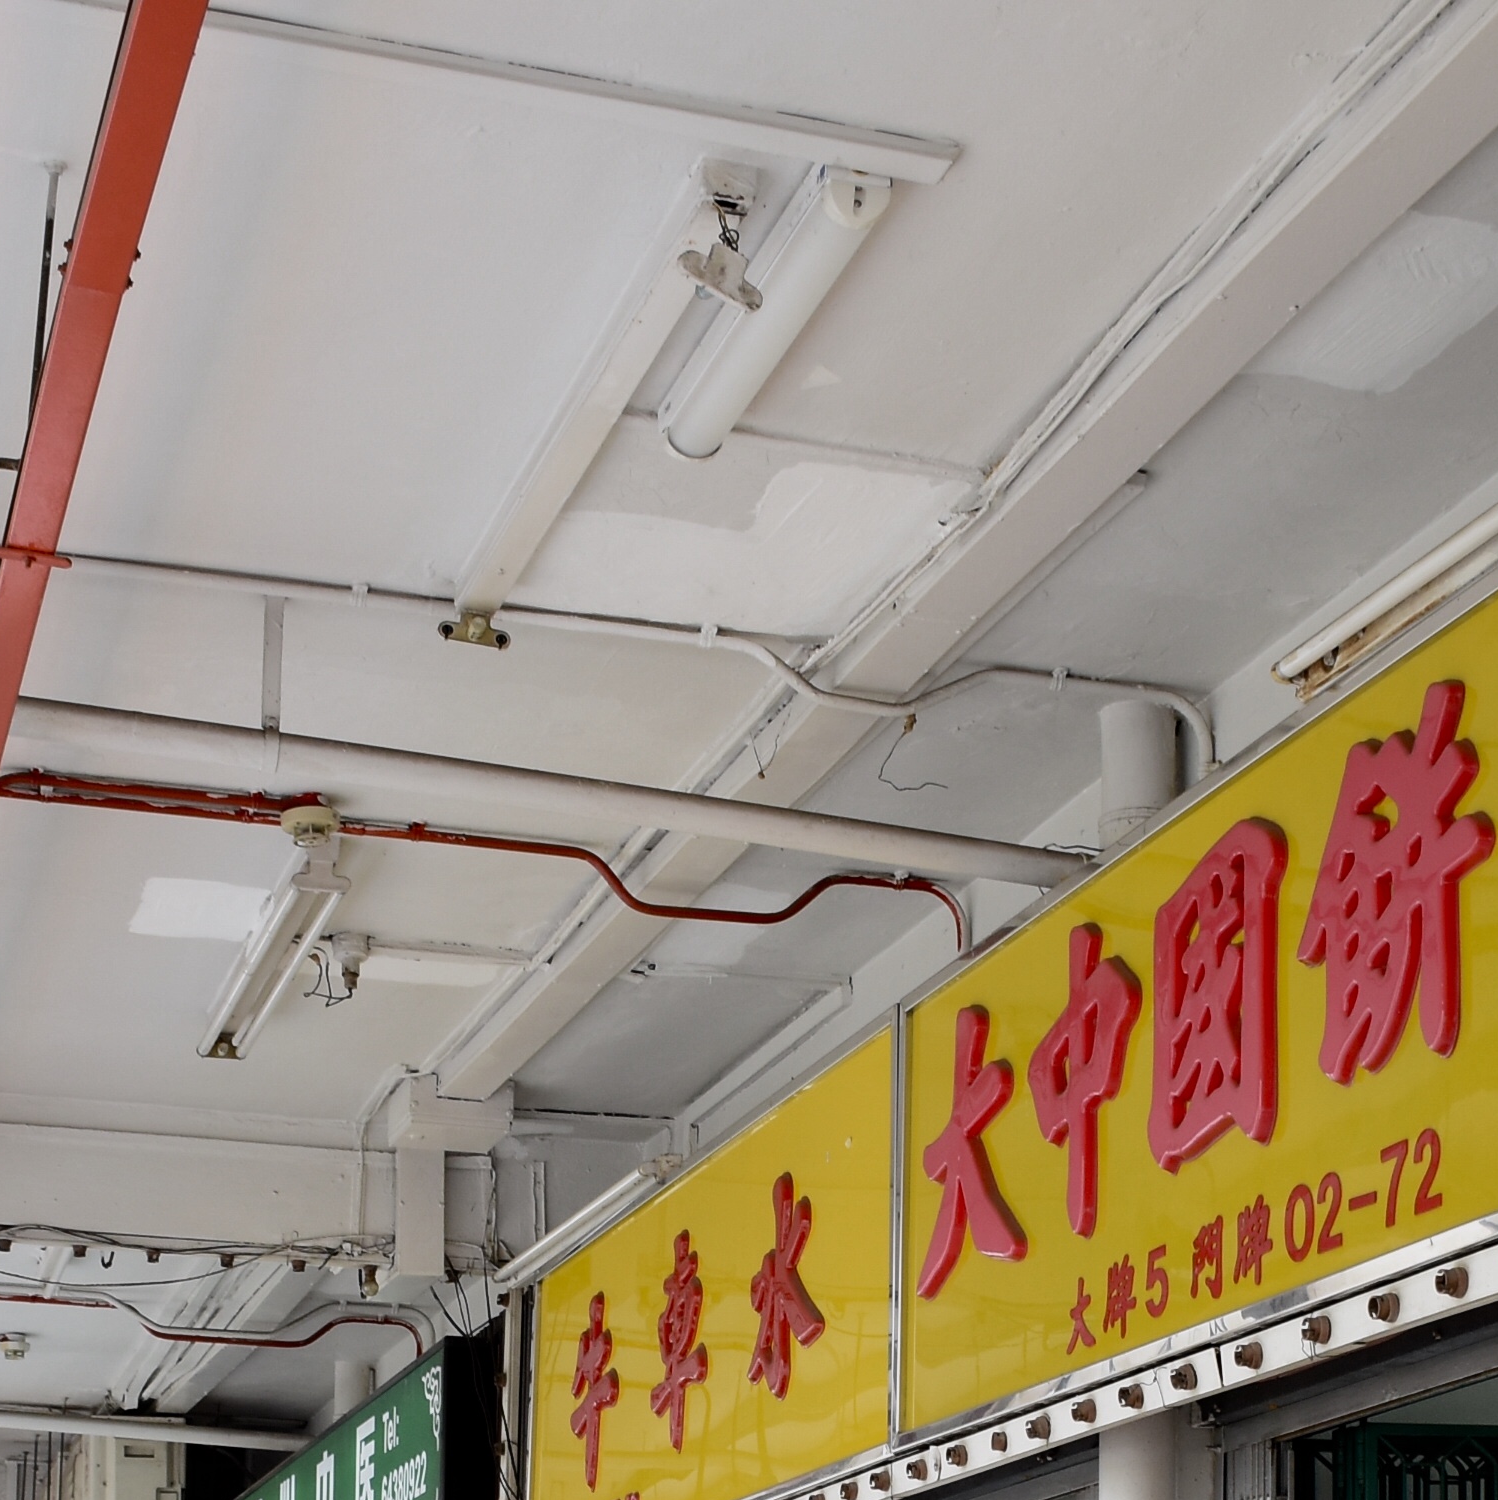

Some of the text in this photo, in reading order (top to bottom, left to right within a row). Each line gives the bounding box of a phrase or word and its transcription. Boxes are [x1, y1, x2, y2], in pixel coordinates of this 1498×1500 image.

[570, 1171, 825, 1493] 牛車水
[383, 1406, 400, 1453] Tel:
